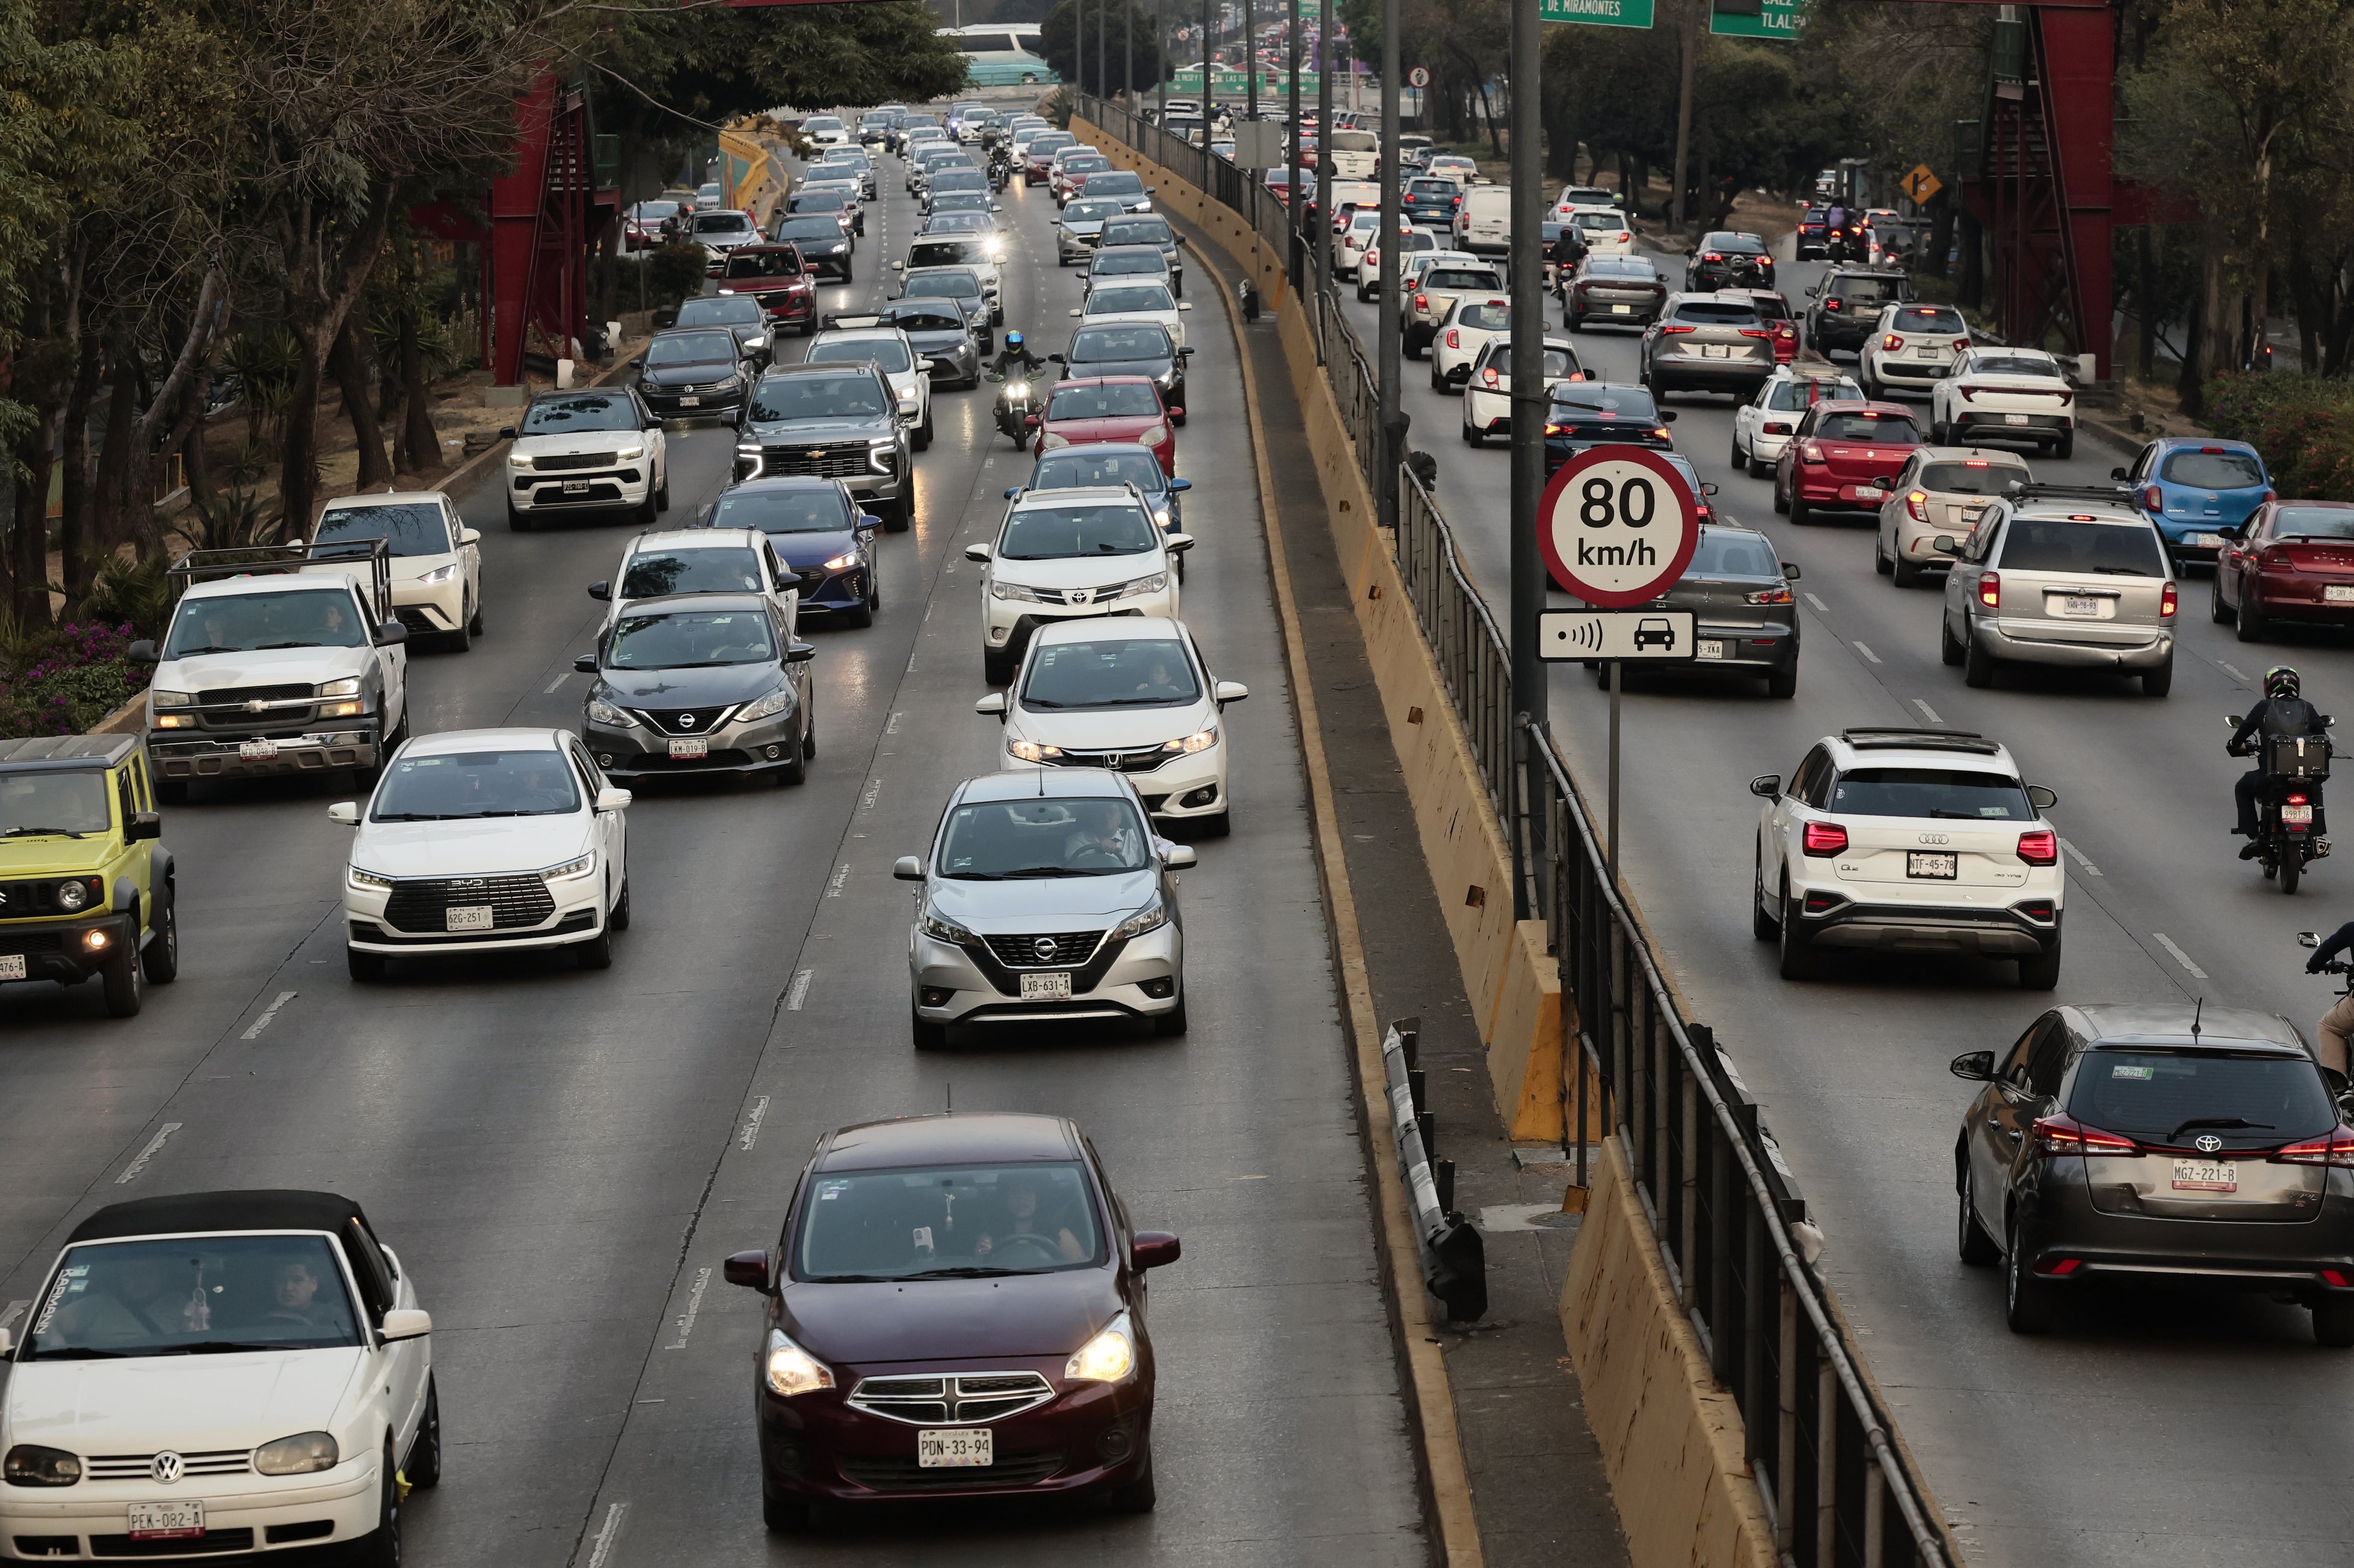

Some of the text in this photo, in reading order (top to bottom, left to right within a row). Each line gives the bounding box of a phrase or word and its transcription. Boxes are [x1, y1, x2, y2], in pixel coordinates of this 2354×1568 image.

[1548, 0, 1559, 11] DE
[1563, 0, 1620, 16] MIRAMONTES
[1761, 13, 1811, 29] TLALPA
[1580, 477, 1655, 528] 80
[1578, 538, 1656, 566] km/h
[242, 747, 276, 756] NFD-048-B
[670, 745, 705, 754] LKM-019-B
[1910, 859, 1954, 872] NTF-45-78
[451, 879, 483, 887] BYD
[449, 913, 481, 924] 62G-251
[1023, 980, 1068, 992] LXB-631-A
[2175, 1167, 2234, 1181] MGZ-221-B
[34, 1269, 74, 1335] KARMANN
[921, 1439, 990, 1456] PDN-33-94
[131, 1512, 200, 1529] PEK-082-A
